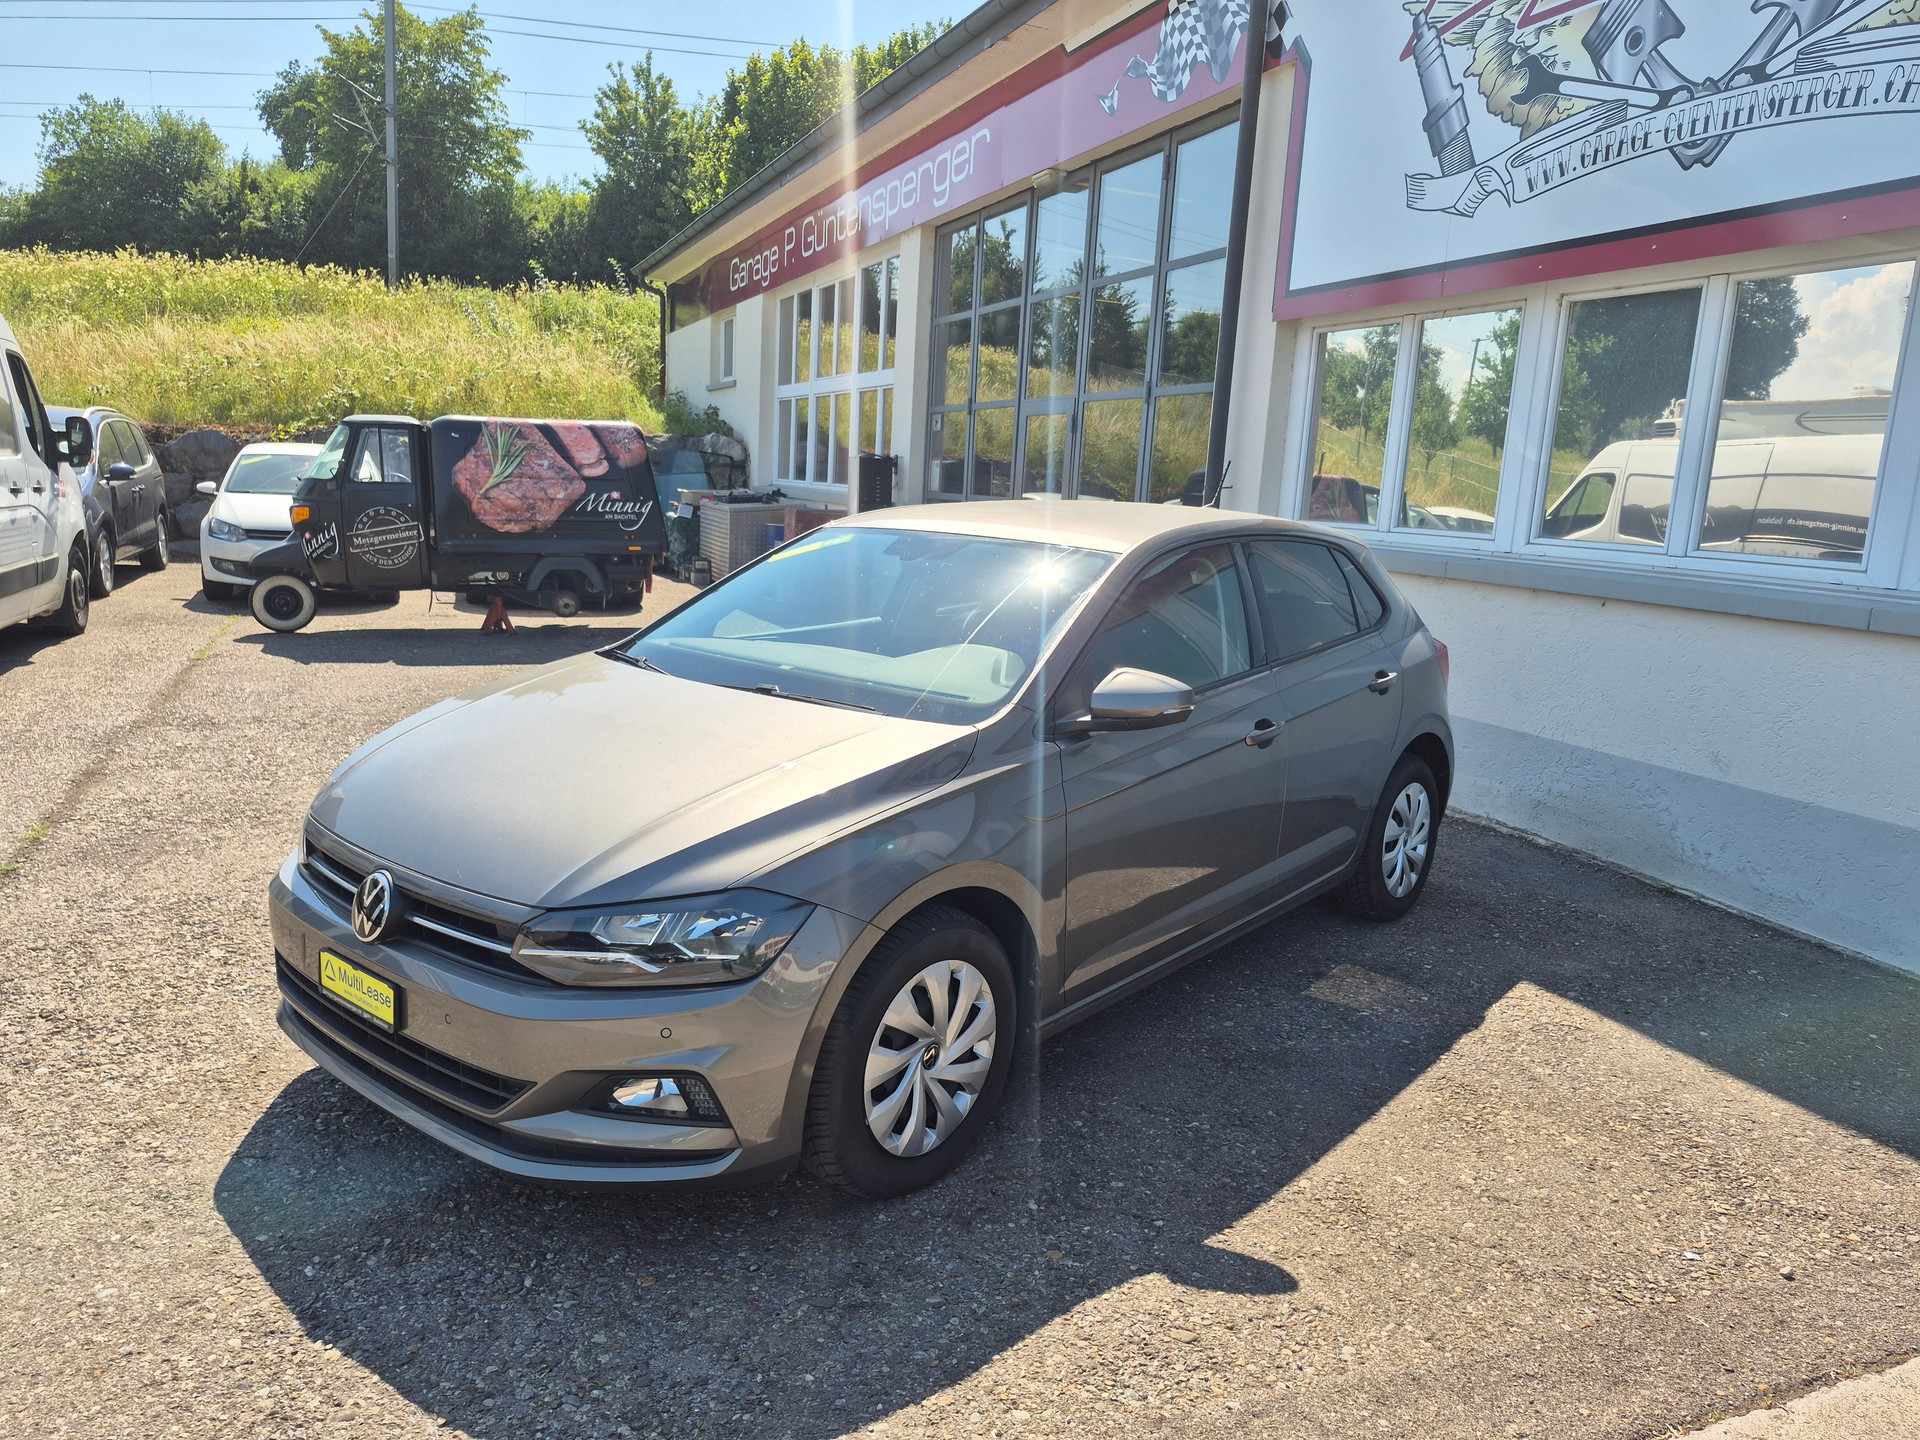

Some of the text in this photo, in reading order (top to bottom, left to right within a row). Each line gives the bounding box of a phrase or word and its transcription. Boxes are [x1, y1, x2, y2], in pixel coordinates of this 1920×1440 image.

[1525, 64, 1920, 193] WWW.GARAGE-GUENTENSPERGER.CH
[729, 128, 990, 292] Garage P. Güntensperger
[575, 492, 653, 531] Minnig
[353, 529, 418, 545] Metzgermeister
[365, 553, 377, 563] AUS
[394, 545, 415, 565] REGION
[338, 965, 392, 1008] MultiLease
